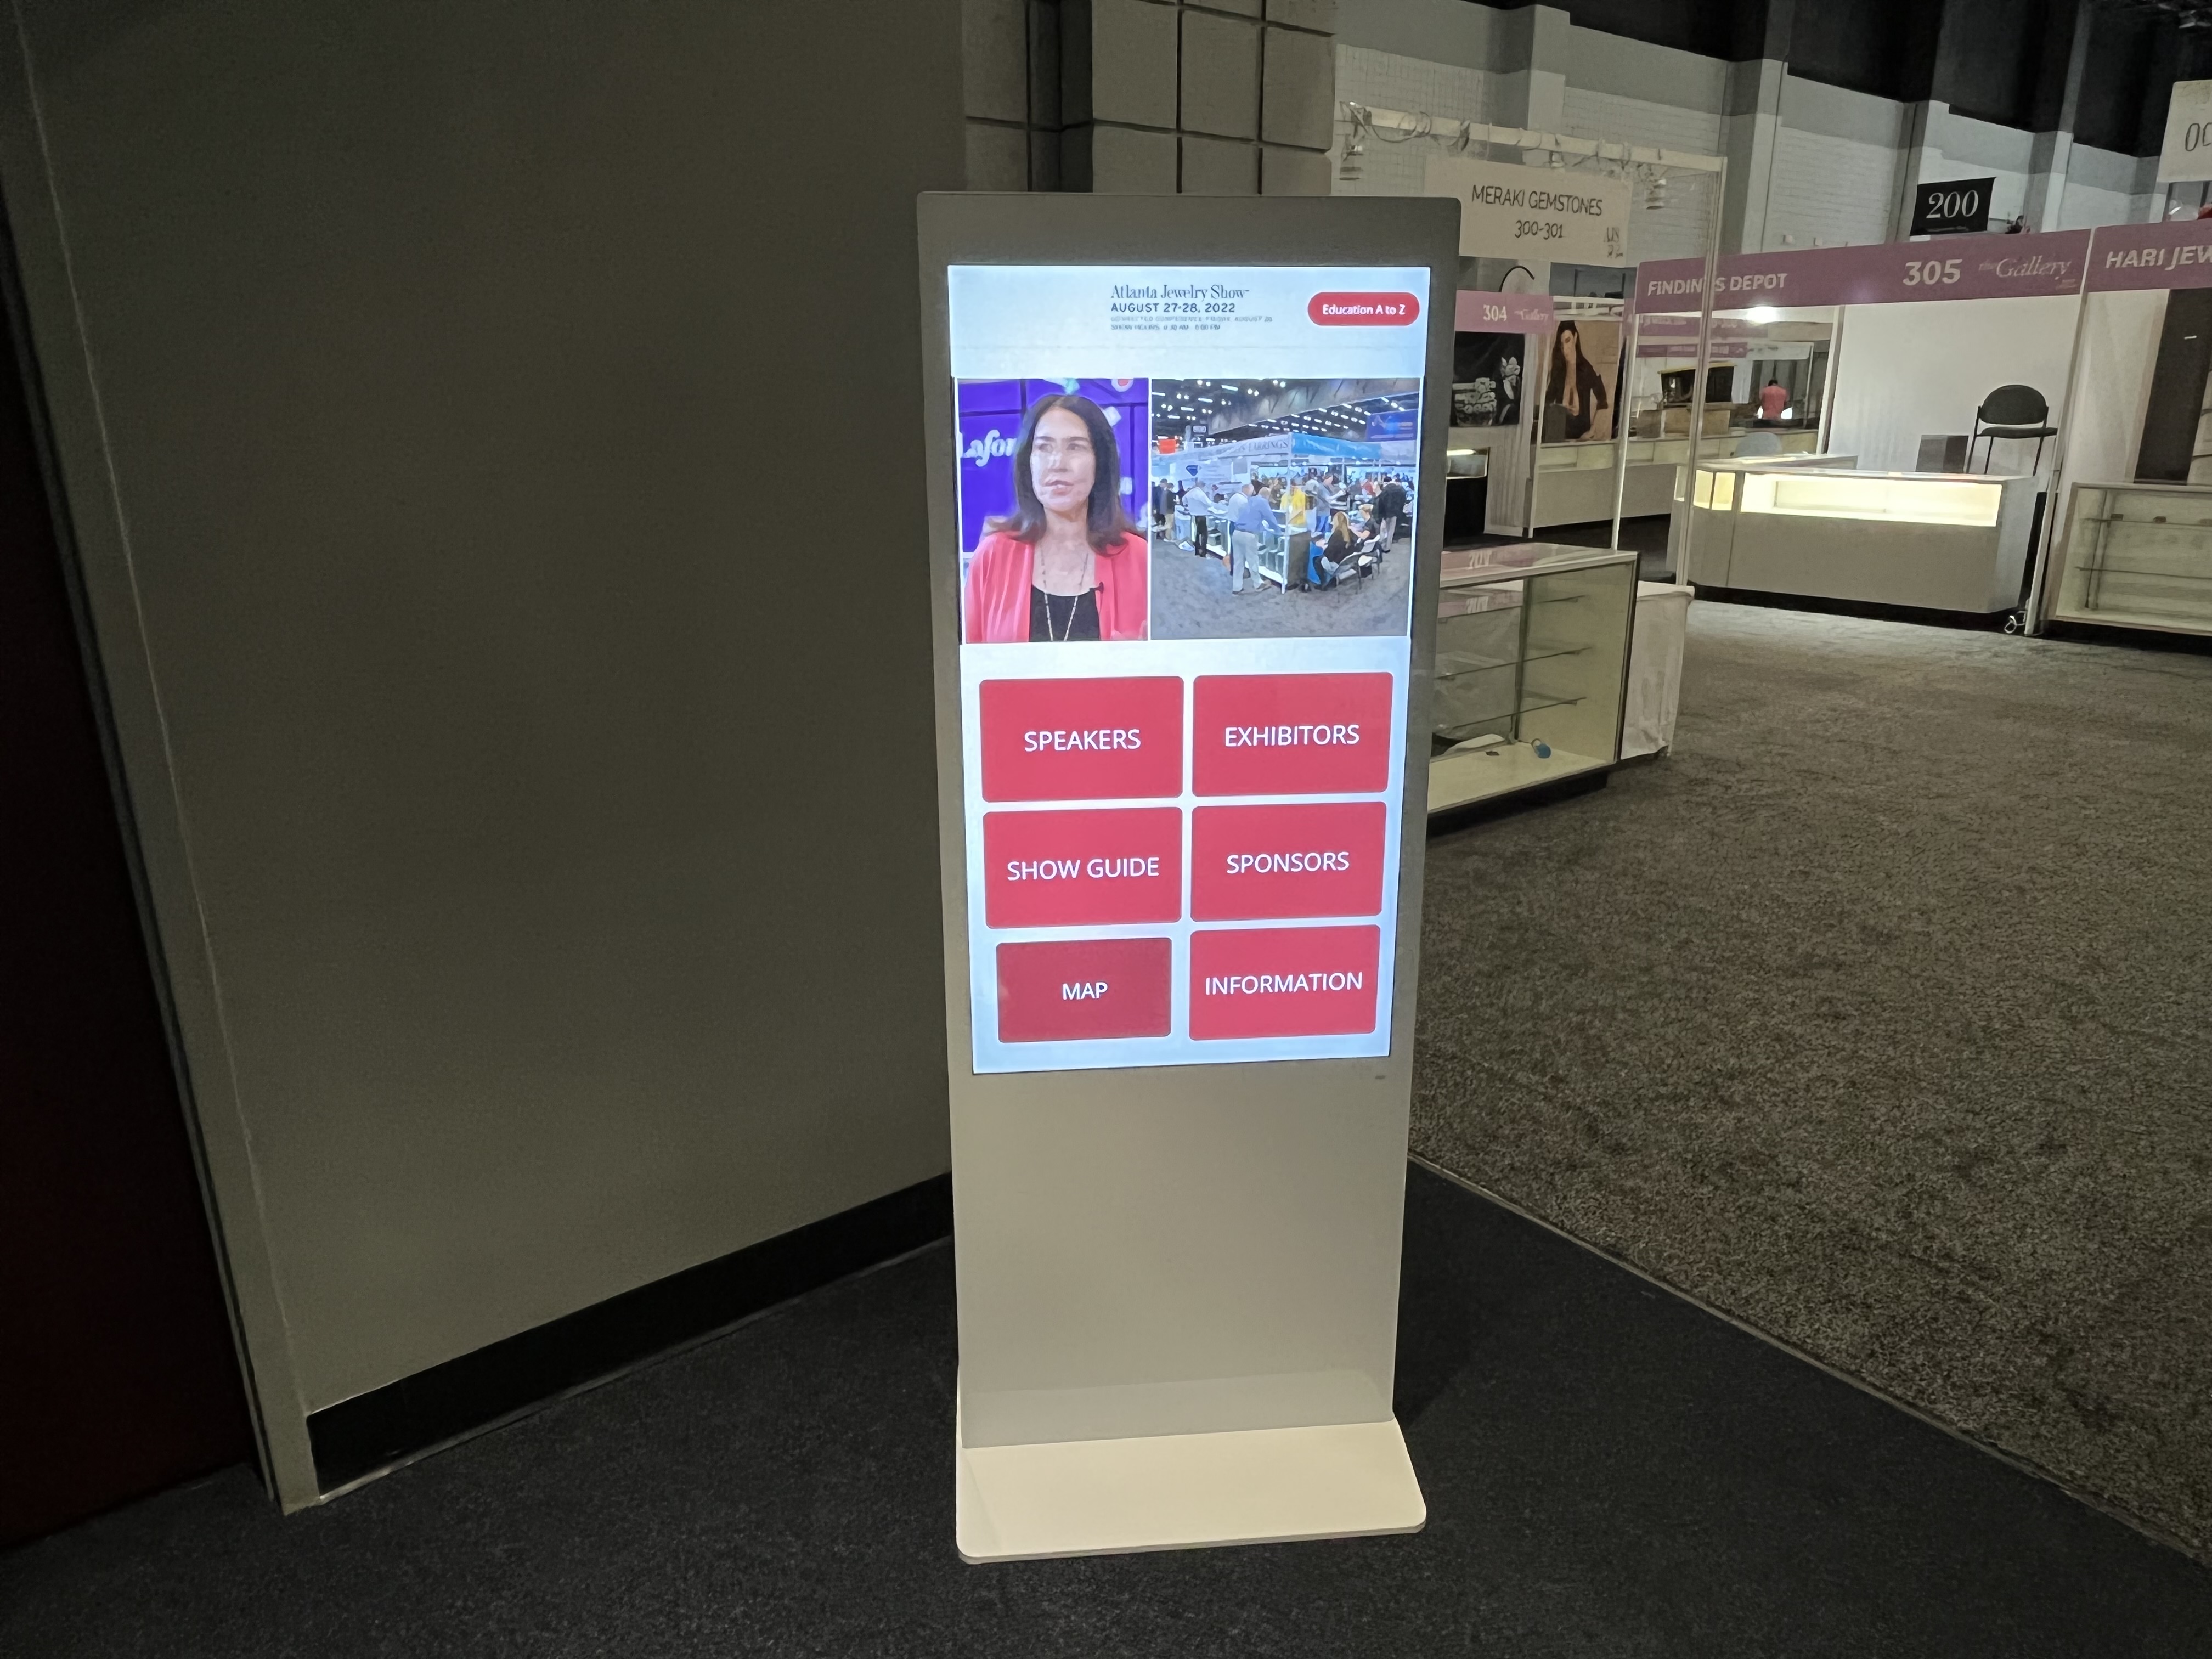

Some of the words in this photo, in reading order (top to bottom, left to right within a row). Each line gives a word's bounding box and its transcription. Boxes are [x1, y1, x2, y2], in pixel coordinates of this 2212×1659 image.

[1471, 184, 1525, 207] MERAKI
[1528, 190, 1603, 216] GEMSTONES
[1926, 190, 1979, 219] 200
[1514, 219, 1564, 240] 300-301
[2106, 248, 2165, 269] HARI
[1903, 259, 1963, 286] 305
[1996, 255, 2072, 280] Gallery
[1110, 284, 1158, 299] Atlanta
[1160, 284, 1208, 301] Jewelry
[1647, 277, 1725, 296] FINDINS
[1730, 273, 1788, 291] DEPOT
[1110, 302, 1160, 313] AUGUST
[1205, 302, 1235, 313] 2022
[1322, 303, 1374, 315] Education
[1375, 304, 1384, 315] A
[1385, 305, 1397, 315] to
[1398, 304, 1406, 315] Z
[1483, 304, 1508, 322] 304
[1023, 728, 1142, 752] SPEAKERS
[1224, 724, 1360, 747] EXHIBITORS
[1007, 859, 1081, 882] SHOW
[1086, 856, 1160, 879] GUIDE
[1226, 851, 1350, 875] SPONSORS
[1062, 981, 1109, 1001] MAP
[1205, 971, 1363, 996] INFORMATION
